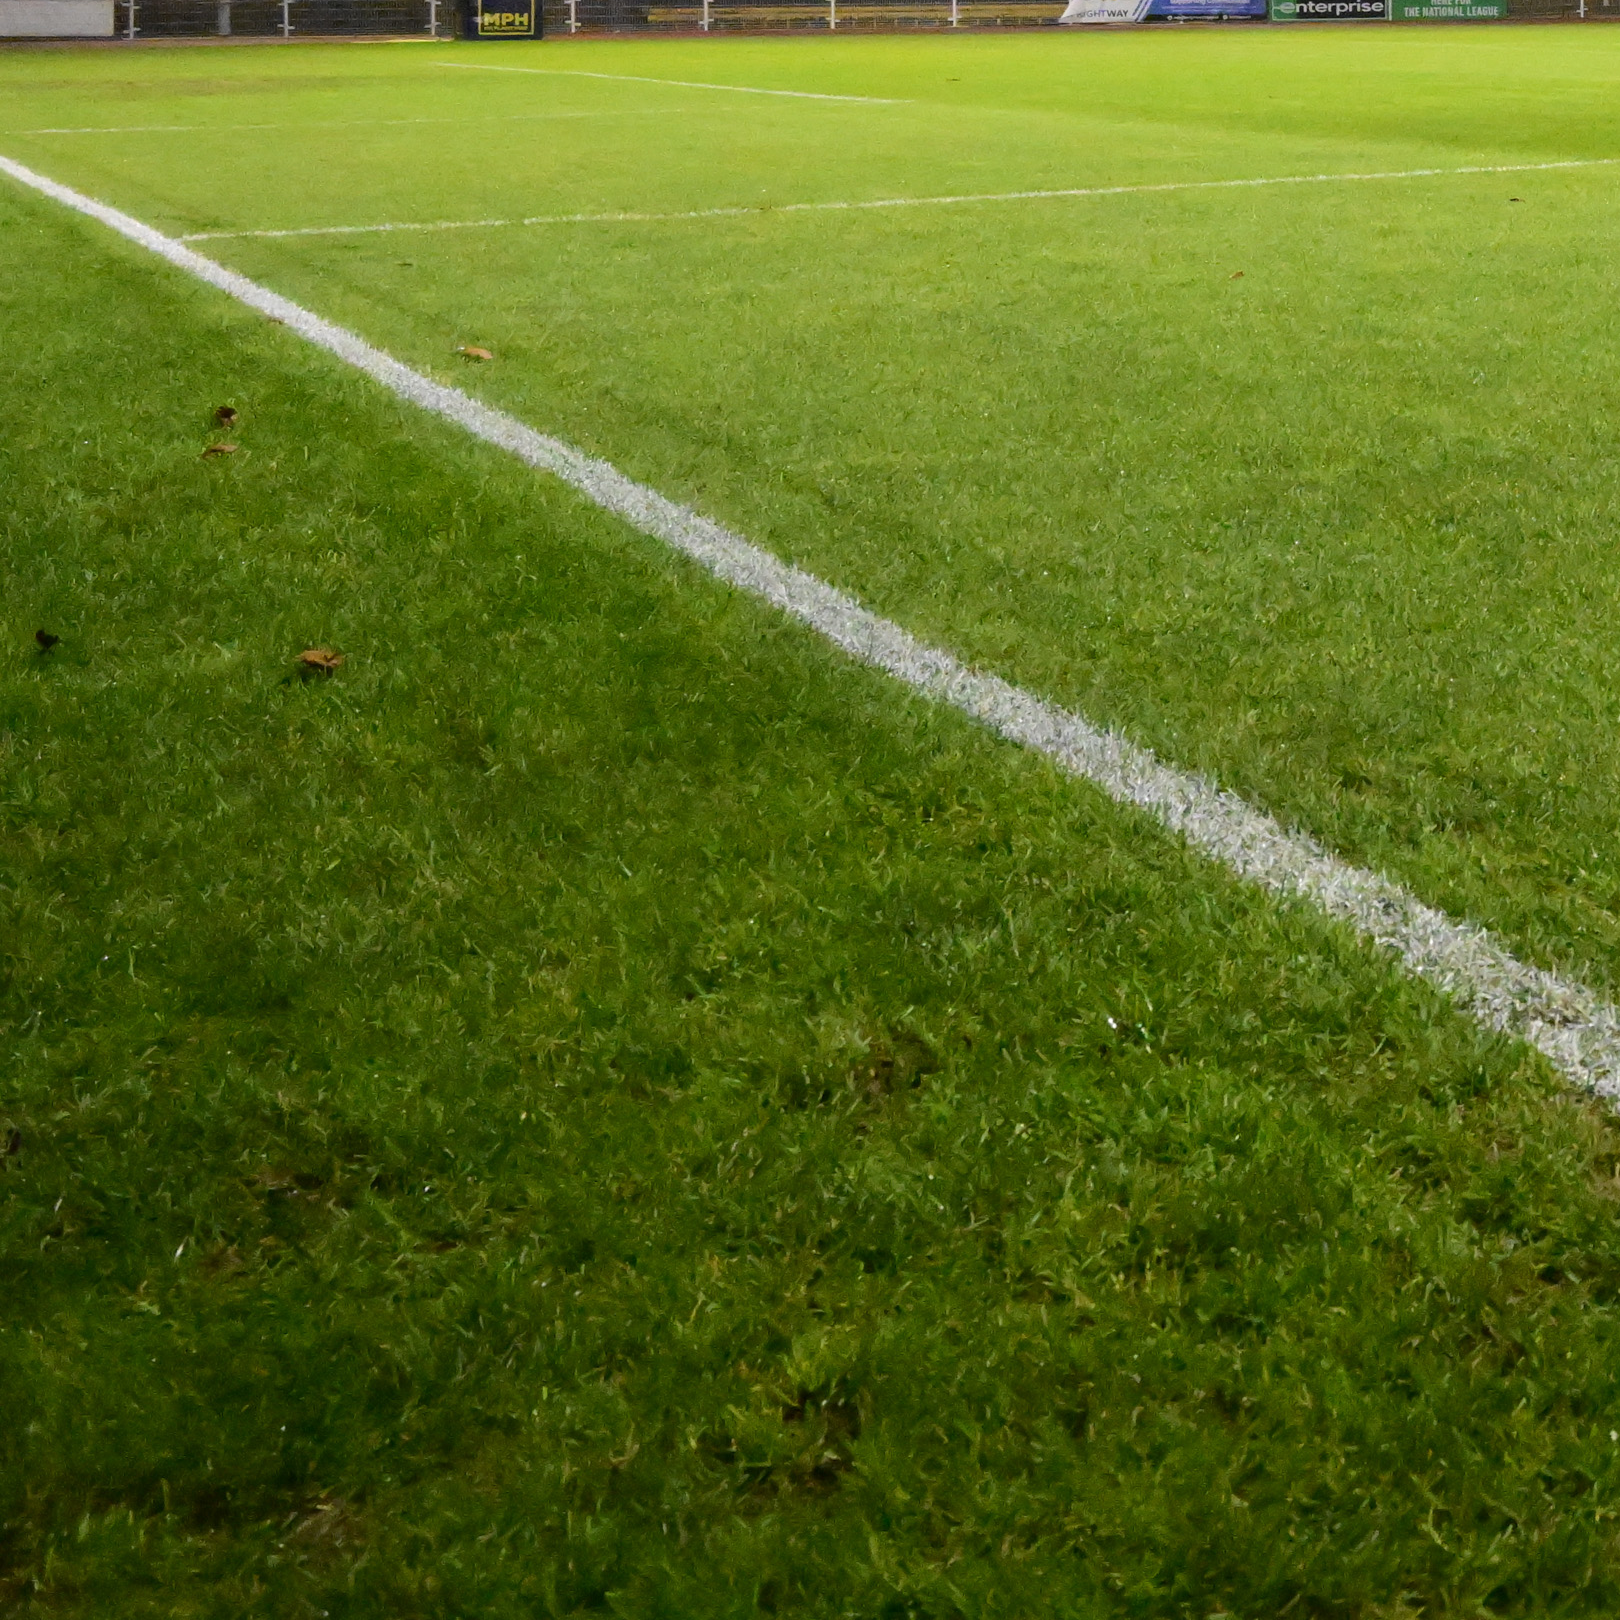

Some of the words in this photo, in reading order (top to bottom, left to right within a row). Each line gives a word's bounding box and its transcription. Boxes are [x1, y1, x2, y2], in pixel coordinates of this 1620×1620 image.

[1280, 0, 1384, 16] enterprise
[1404, 6, 1420, 17] THE
[1422, 6, 1464, 17] NATIONAL
[1466, 5, 1499, 16] LEAGUE
[484, 12, 529, 26] MPH
